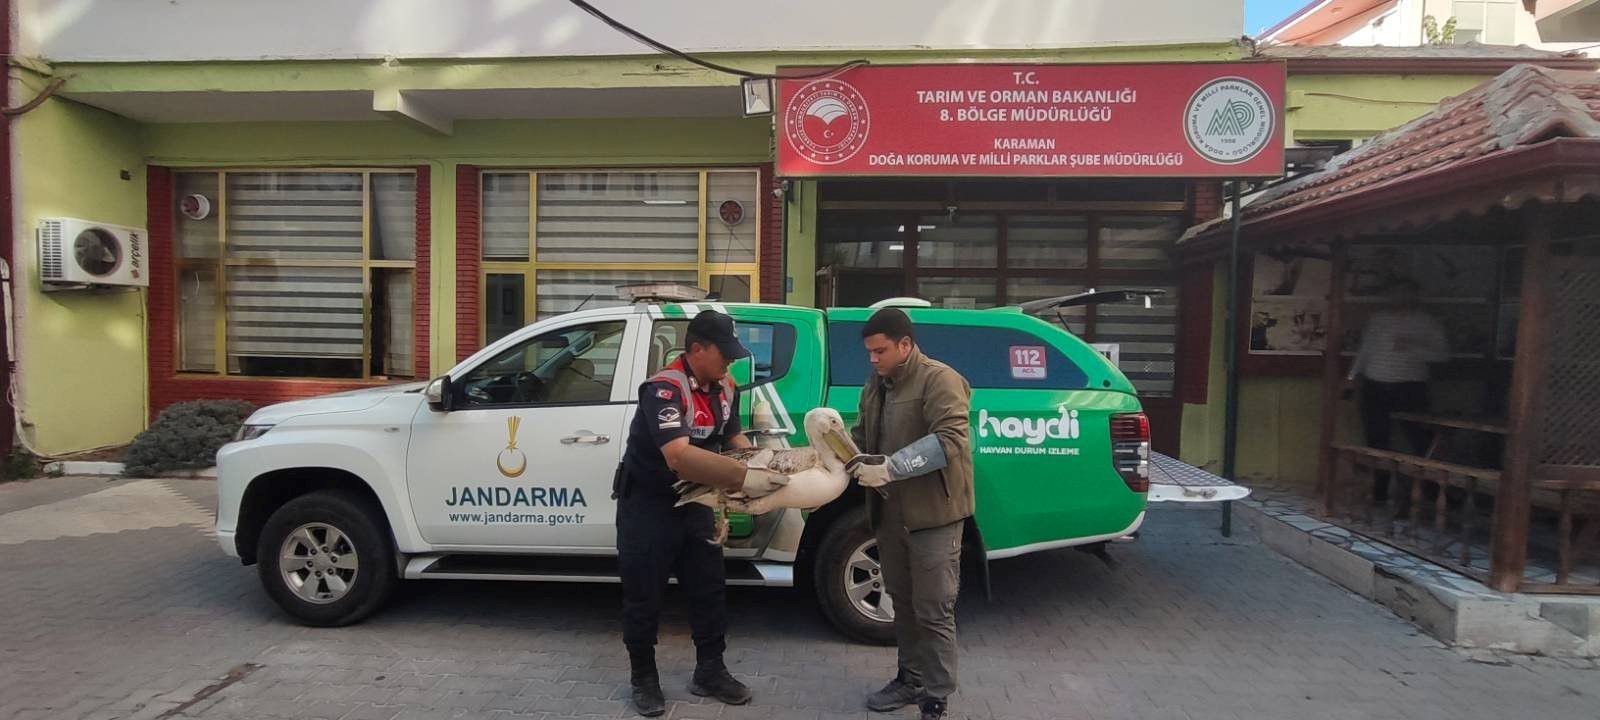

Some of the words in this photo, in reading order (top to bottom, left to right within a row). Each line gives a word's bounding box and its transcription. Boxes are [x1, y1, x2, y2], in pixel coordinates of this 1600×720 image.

[1013, 72, 1039, 85] T.C.
[916, 91, 964, 104] TARIM
[967, 91, 987, 104] VE
[990, 91, 1049, 104] ORMAN
[1052, 89, 1137, 104] BAKANLIĞI
[1193, 103, 1202, 112] VE
[1220, 84, 1254, 98] PARKLAR
[939, 109, 953, 121] 8.
[957, 106, 1007, 122] BÖLGE
[1011, 106, 1112, 122] MÜDÜRLÜĞÜ
[994, 138, 1055, 150] KARAMAN
[869, 153, 904, 166] DOĞA
[907, 155, 960, 166] KORUMA
[961, 155, 977, 166] VE
[979, 153, 1010, 166] MİLLİ
[1013, 155, 1068, 166] PARKLAR
[1070, 154, 1101, 168] ŞUBE
[1103, 153, 1183, 166] MÜDÜRLÜĞÜ
[129, 231, 141, 268] arçelik
[1015, 349, 1041, 365] 112
[979, 405, 1079, 444] haydi
[979, 446, 1012, 454] HAYVAN
[1015, 447, 1046, 455] DURUM
[445, 486, 588, 507] JANDARMA
[448, 511, 585, 526] www.jandarma.gov.tr
